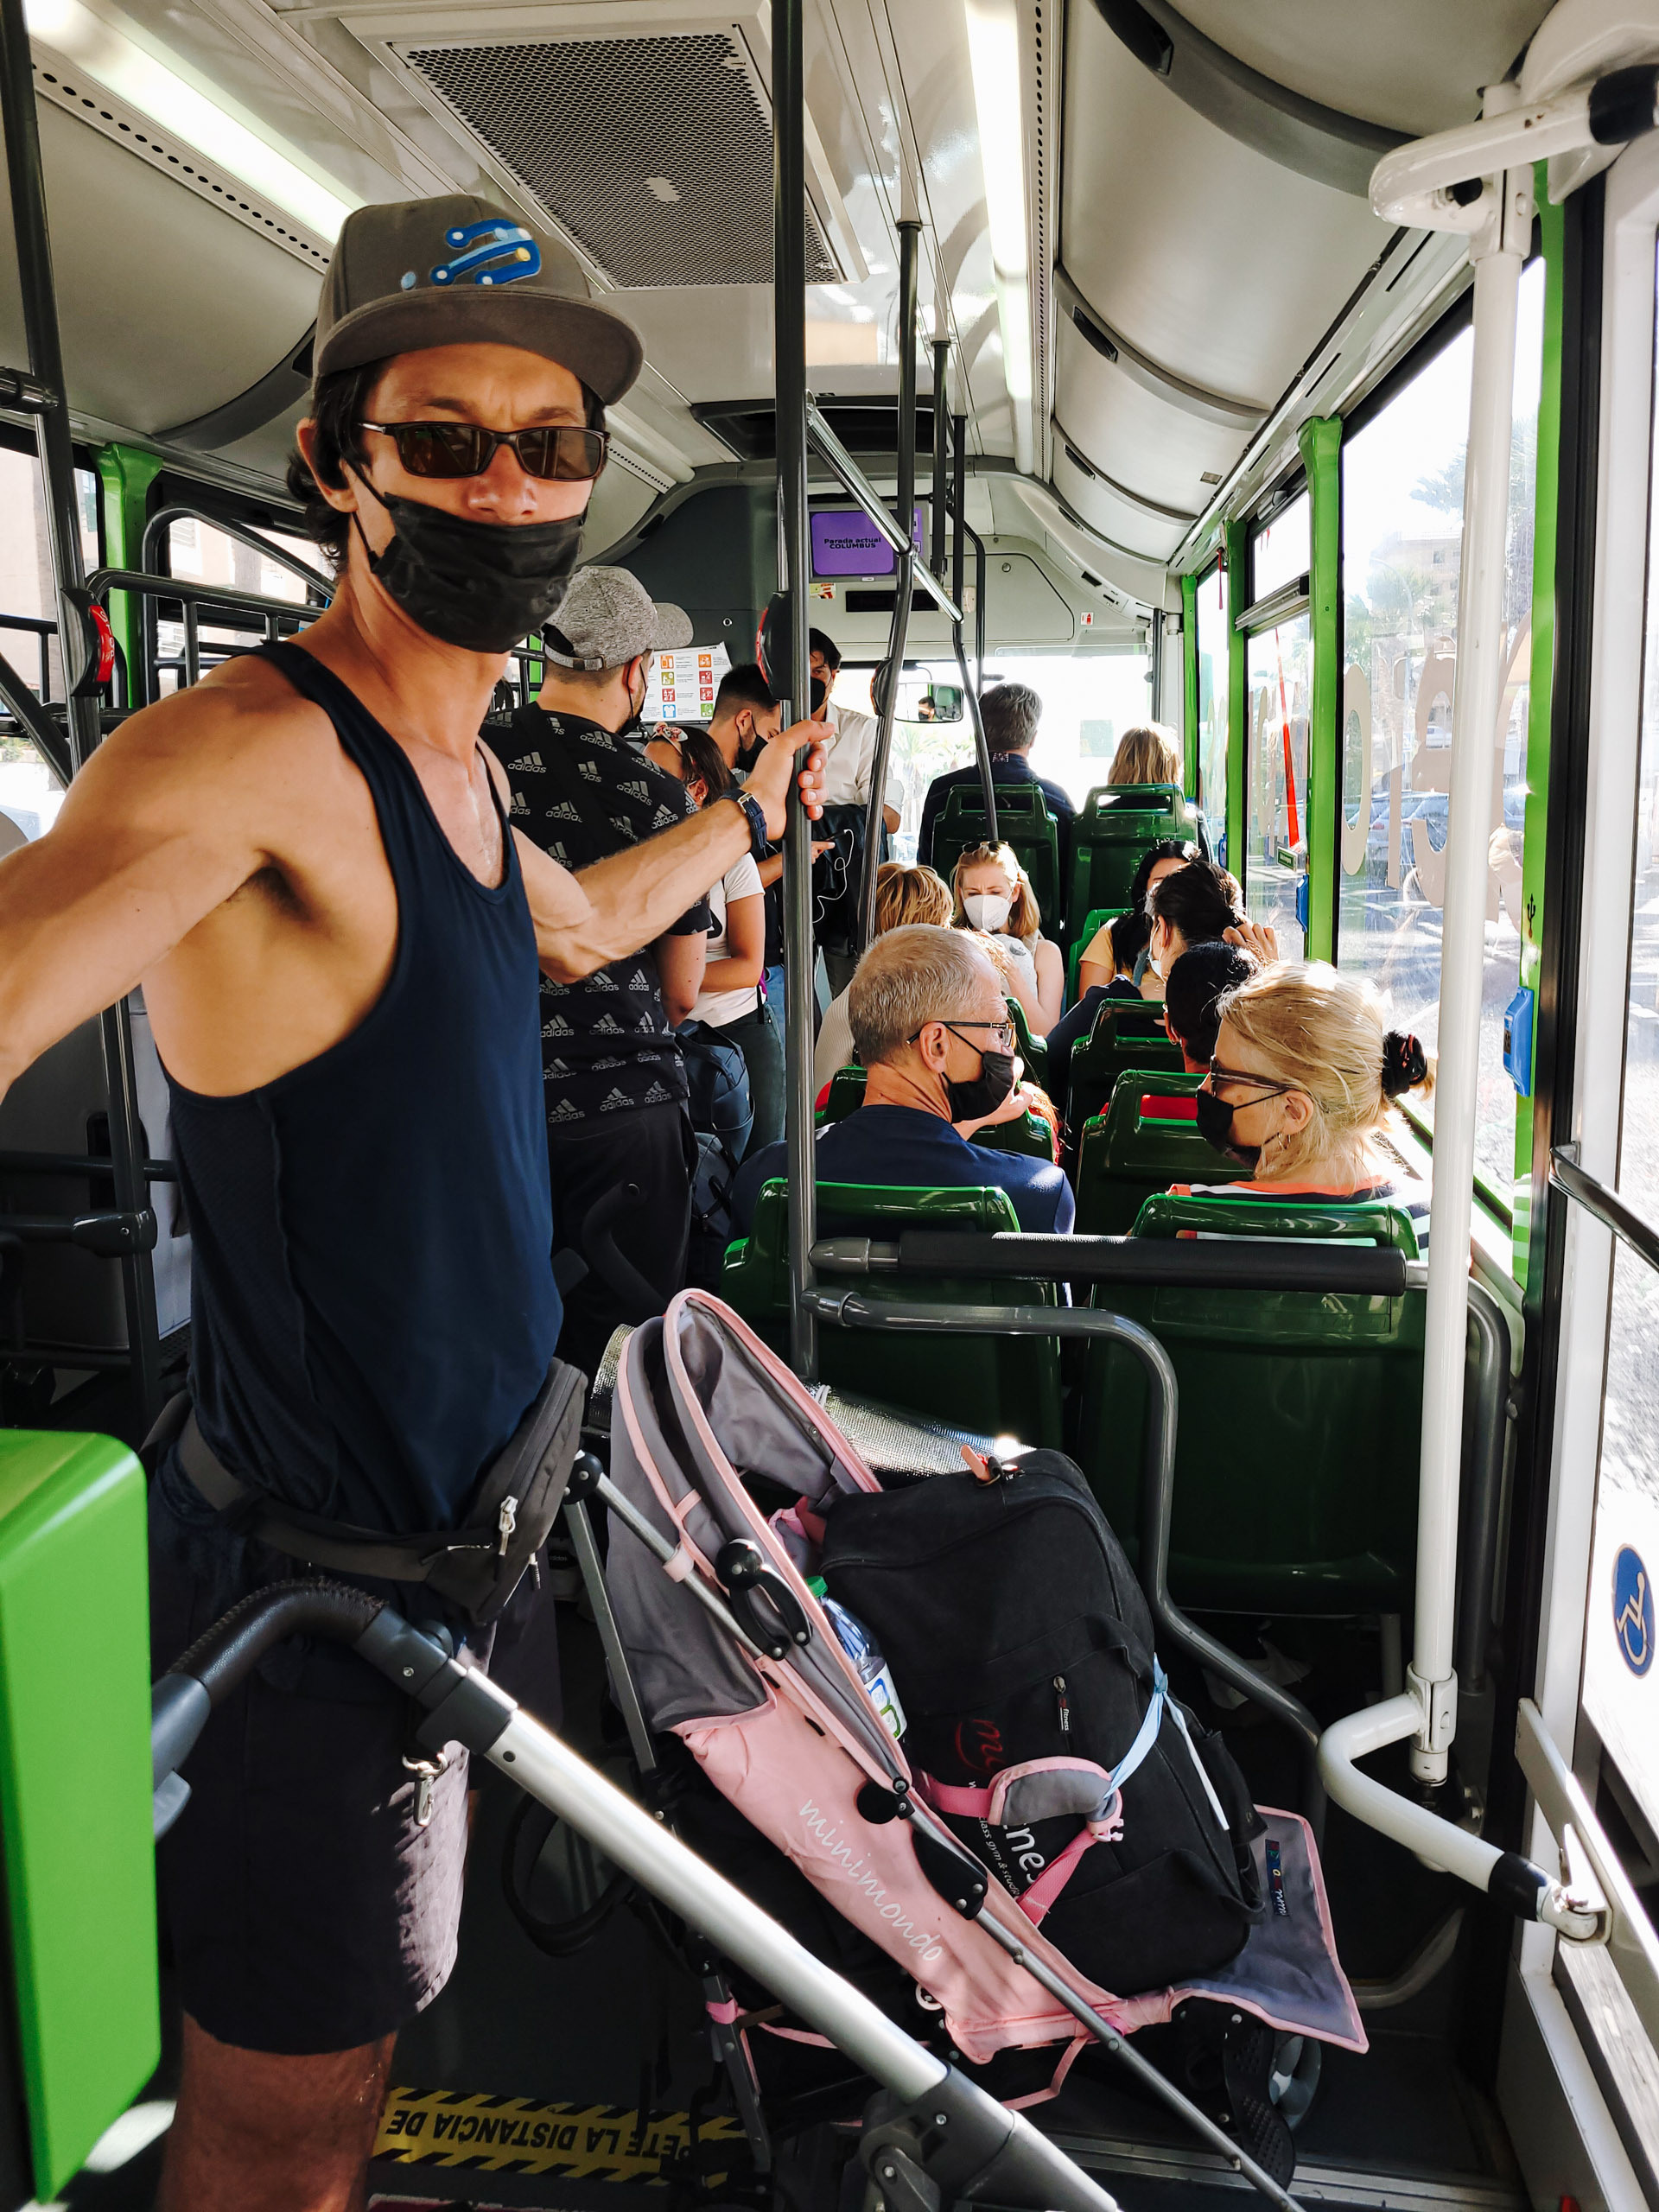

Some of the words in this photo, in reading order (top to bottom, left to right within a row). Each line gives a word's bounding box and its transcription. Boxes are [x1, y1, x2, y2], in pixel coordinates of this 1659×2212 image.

[100, 610, 114, 661] STOP
[580, 733, 618, 753] adidas
[507, 762, 547, 773] adidas
[616, 784, 653, 806] adidas
[652, 813, 678, 830] adidas
[585, 984, 620, 993] adidas
[628, 982, 650, 991] adidas
[540, 1027, 575, 1037] adidas
[589, 1026, 625, 1036] adidas
[600, 1096, 634, 1112] adidas
[644, 1091, 672, 1103] adidas
[548, 1109, 586, 1123] adidas
[986, 1840, 1001, 1861] gym
[799, 1799, 944, 1961] minimondo
[385, 2109, 429, 2137] DE
[433, 2113, 579, 2152] DISTANCIA
[586, 2126, 621, 2154] LA
[625, 2130, 691, 2160] PETE
